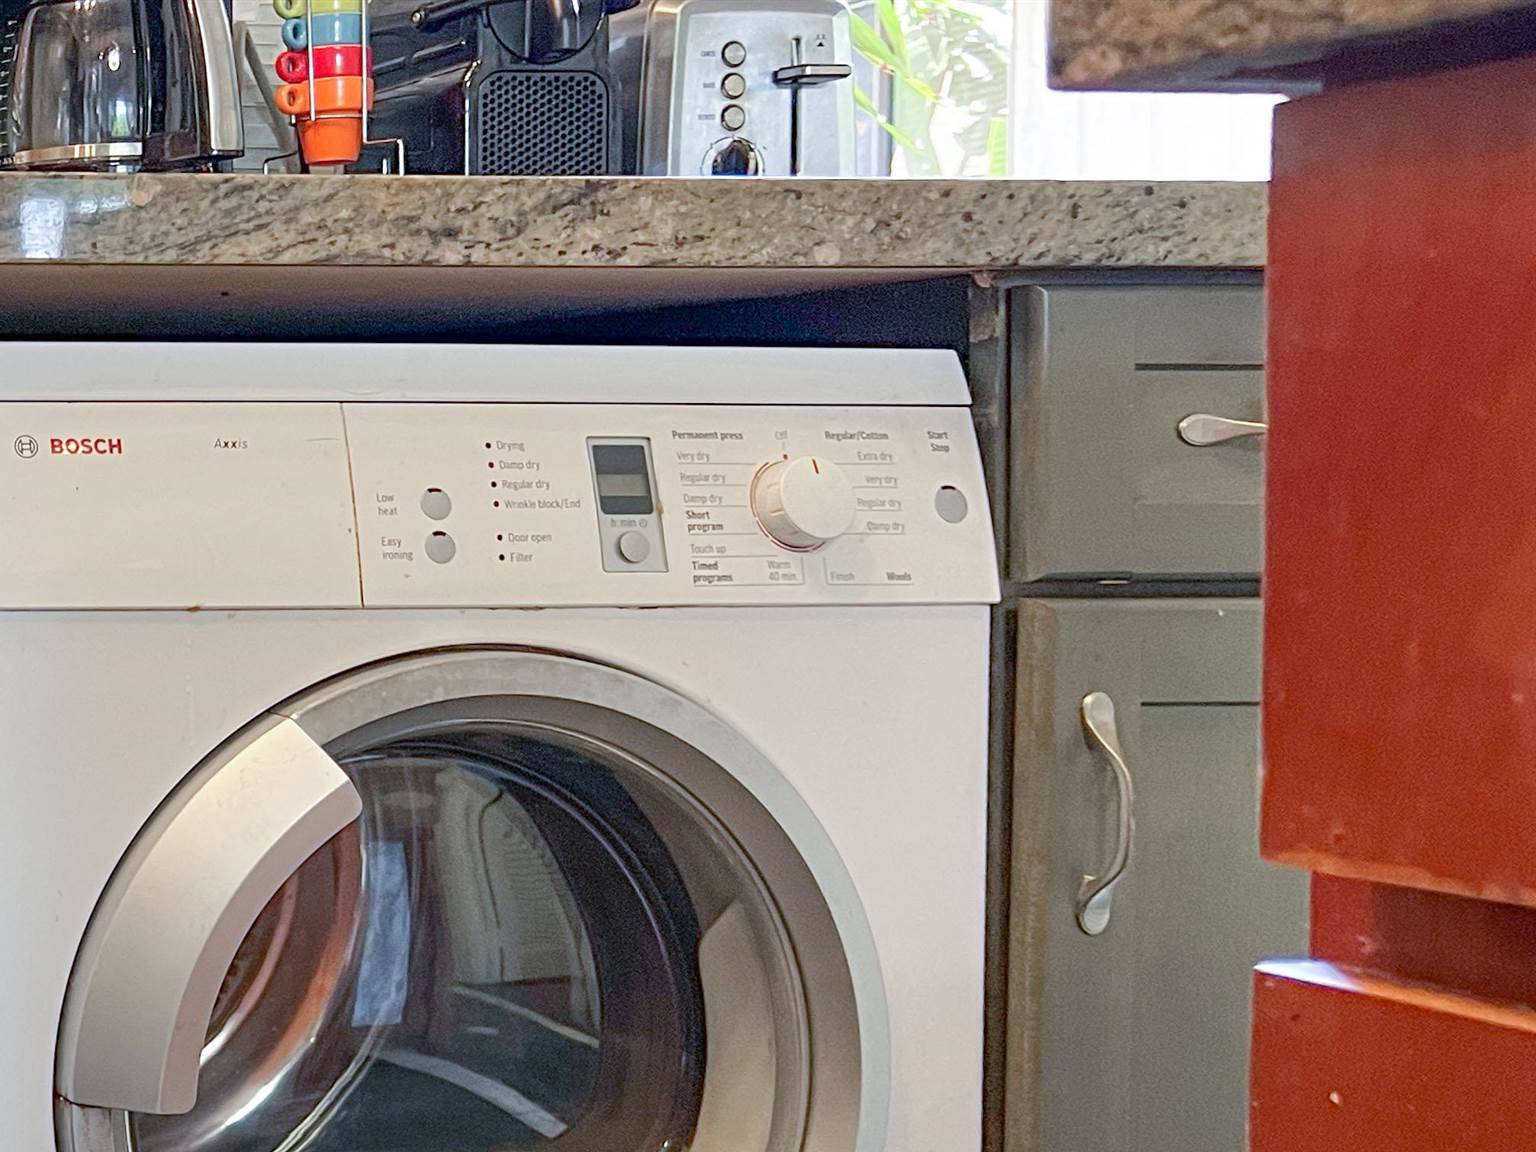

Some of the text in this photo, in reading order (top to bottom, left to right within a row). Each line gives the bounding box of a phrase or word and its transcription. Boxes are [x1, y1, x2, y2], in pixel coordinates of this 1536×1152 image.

[671, 430, 744, 442] Permanent press
[824, 431, 889, 442] Regular/Cotton
[927, 431, 948, 440] Start
[49, 438, 123, 455] BOSCH
[213, 438, 248, 450] Axxis
[496, 441, 525, 452] Drying
[930, 443, 950, 453] Stop
[696, 451, 710, 462] dry
[499, 460, 540, 471] Damp dry
[679, 472, 726, 484] Regular dry
[501, 480, 550, 491] Regular dry
[376, 493, 395, 503] Low
[708, 493, 723, 505] dry
[378, 506, 397, 516] heat
[685, 510, 710, 520] Short
[687, 523, 724, 534] program
[381, 537, 402, 548] Easy
[508, 533, 553, 544] Door open
[382, 550, 413, 561] ironing
[510, 552, 534, 562] Filter
[692, 561, 719, 571] Timed
[693, 574, 734, 585] programs
